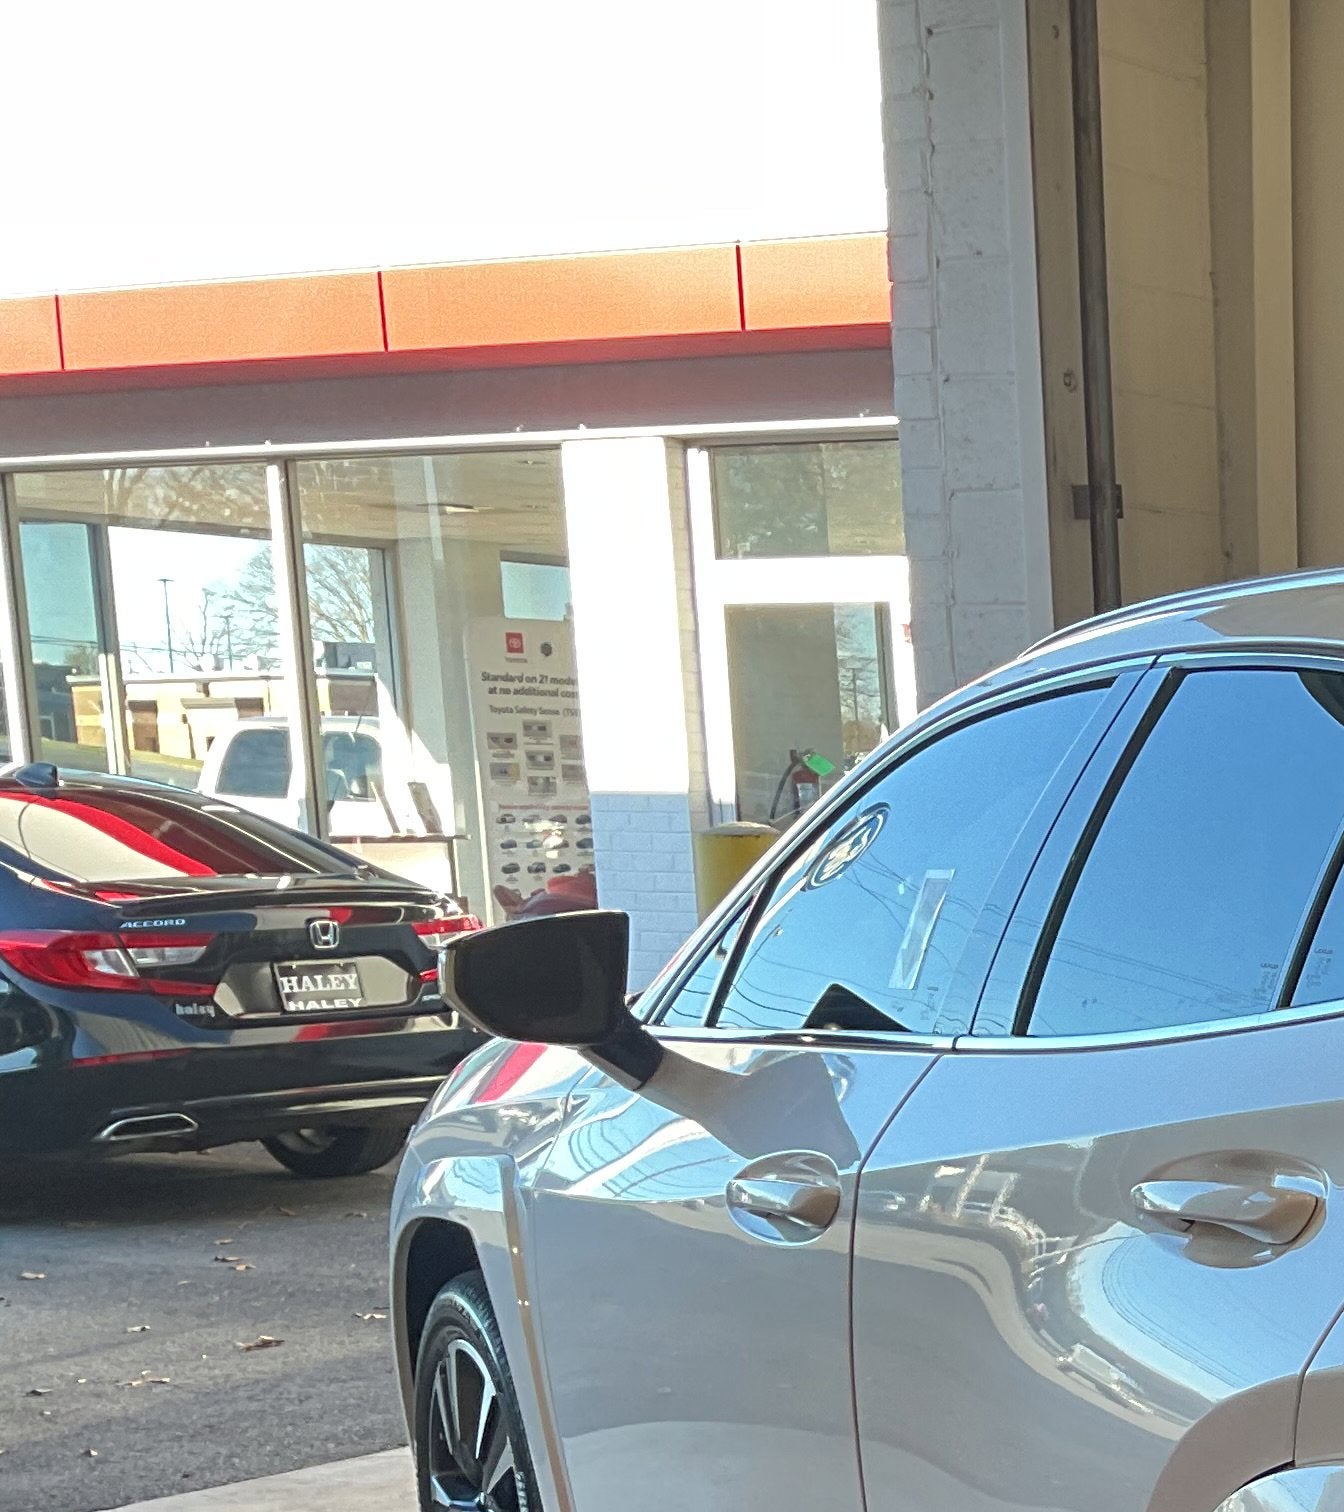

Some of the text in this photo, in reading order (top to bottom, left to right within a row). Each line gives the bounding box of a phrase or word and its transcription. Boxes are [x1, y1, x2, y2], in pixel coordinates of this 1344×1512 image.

[481, 671, 524, 683] Standard
[525, 675, 537, 683] on
[539, 674, 548, 684] 21
[488, 686, 498, 694] at
[499, 687, 512, 695] no
[513, 687, 559, 697] additional
[120, 919, 186, 928] ACCORD
[279, 973, 358, 993] HALEY
[288, 998, 362, 1012] HALEY
